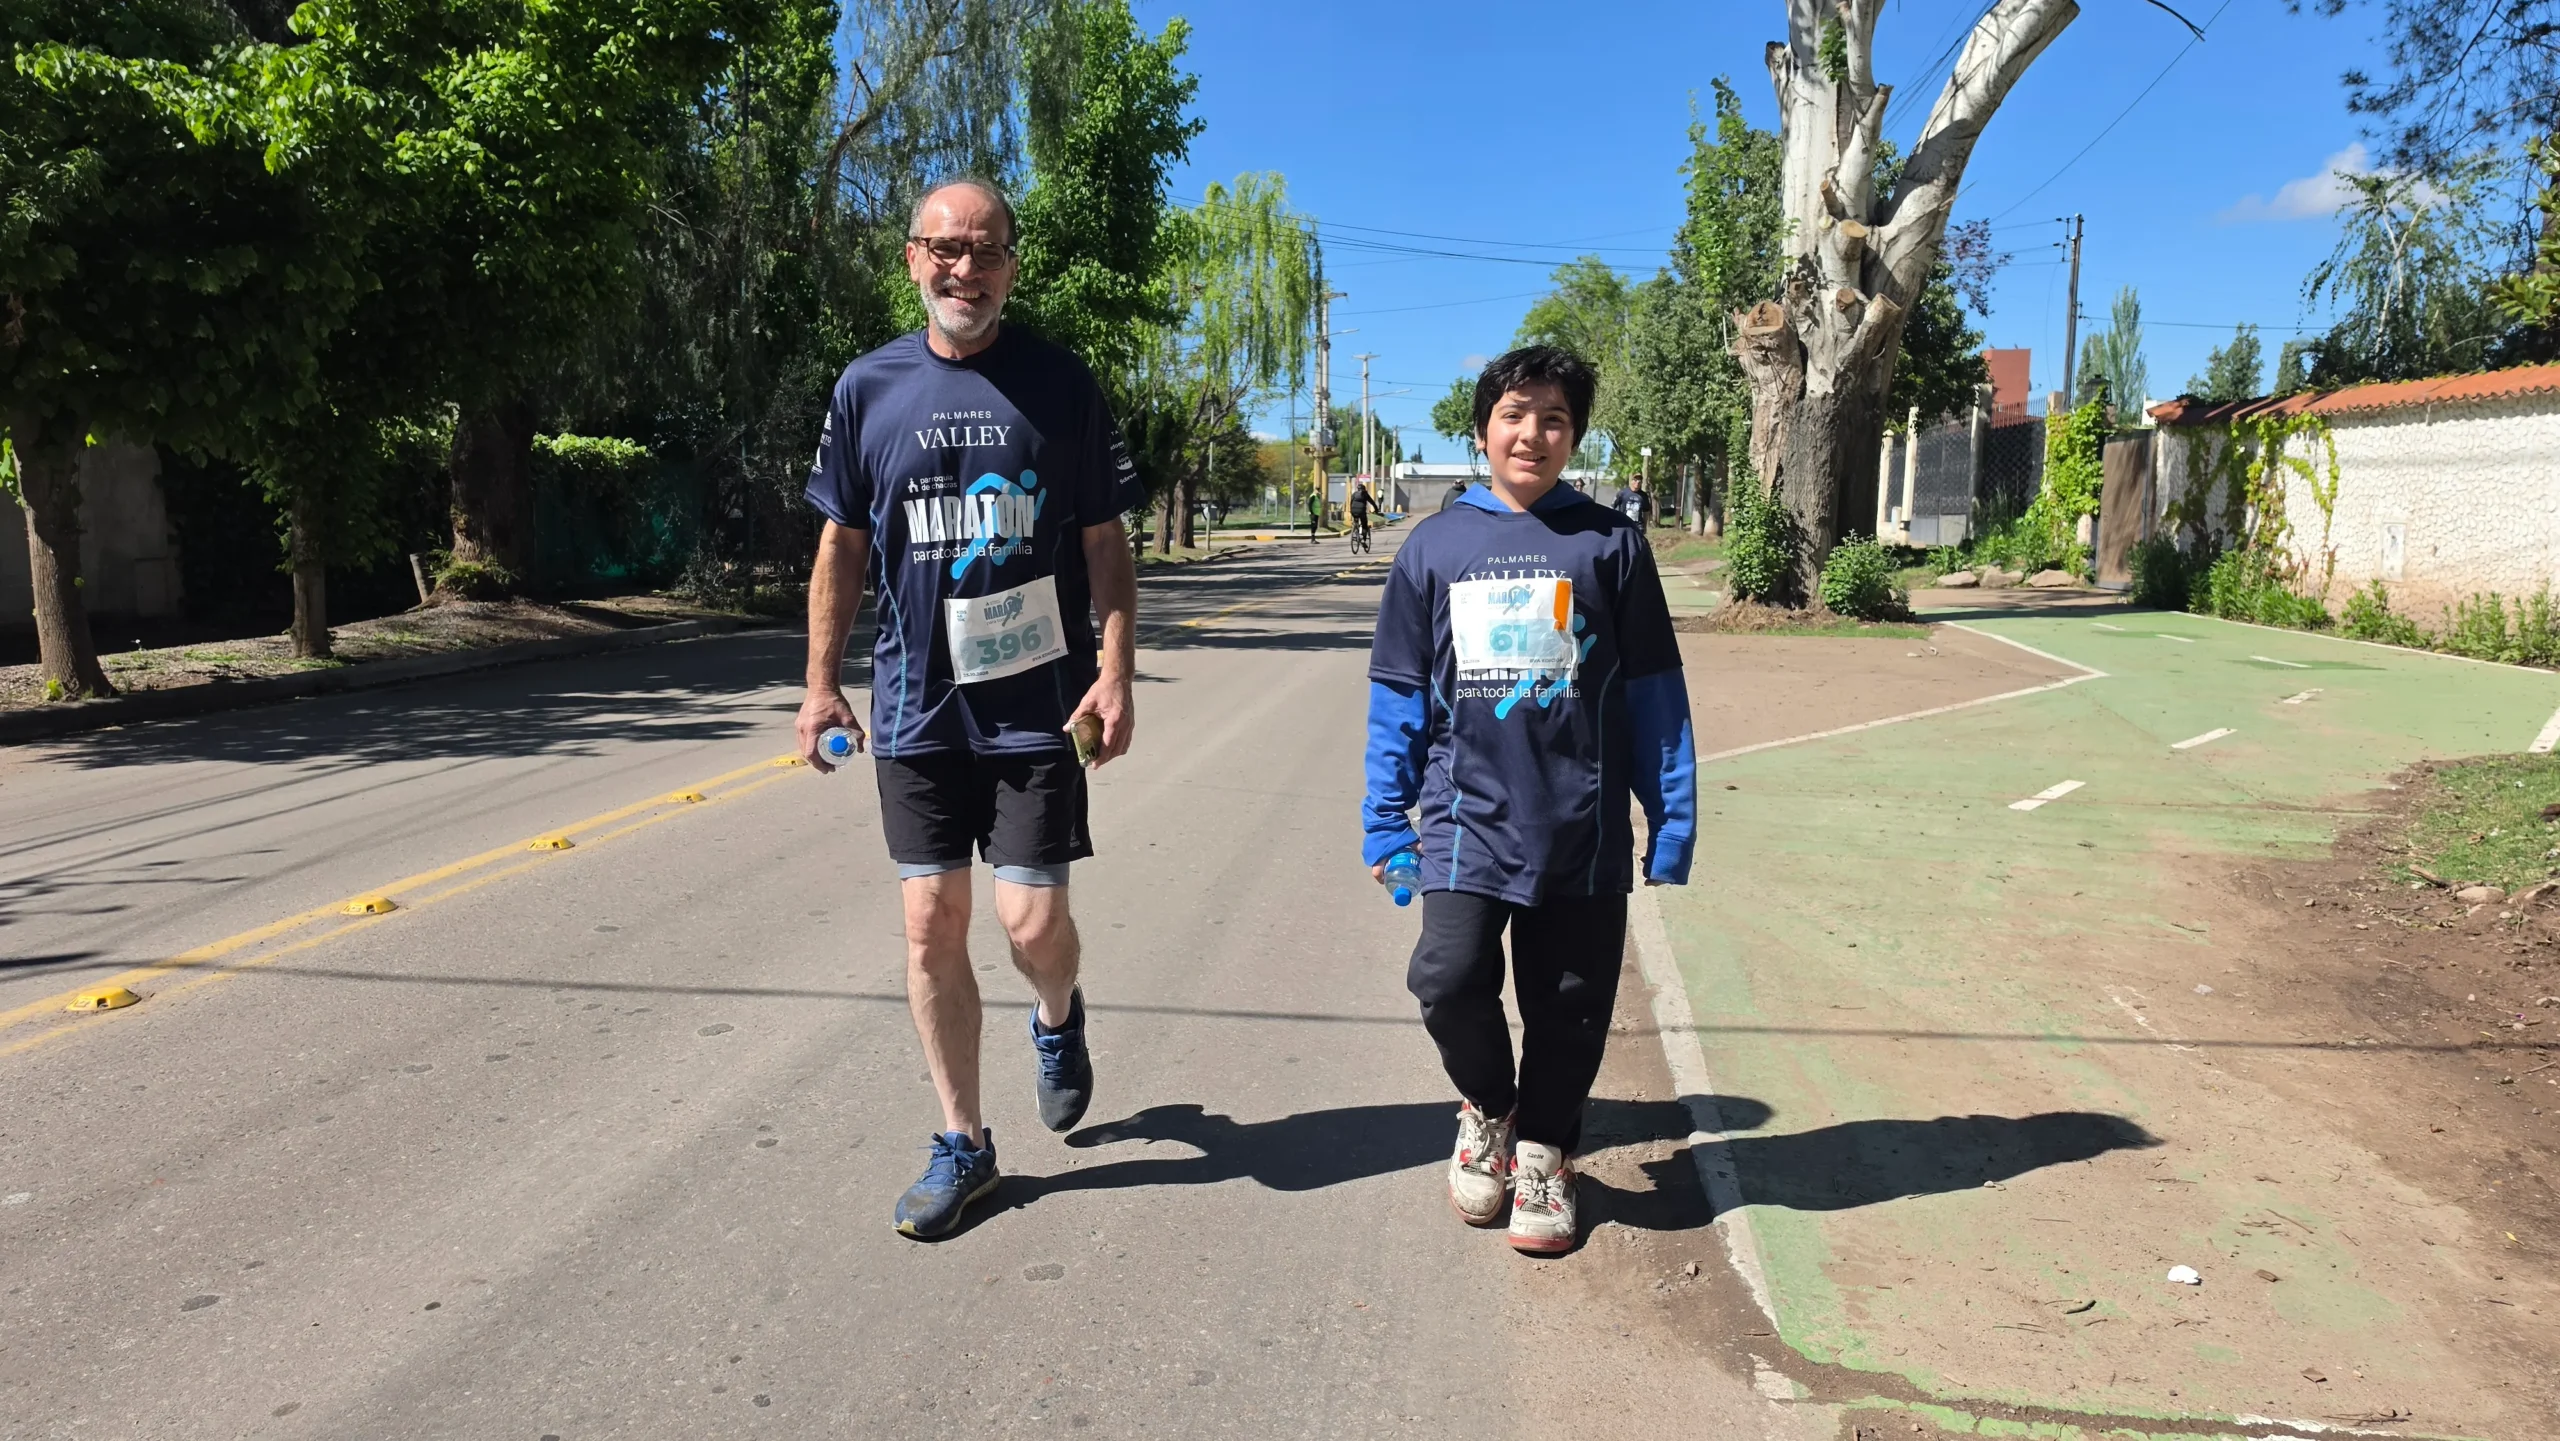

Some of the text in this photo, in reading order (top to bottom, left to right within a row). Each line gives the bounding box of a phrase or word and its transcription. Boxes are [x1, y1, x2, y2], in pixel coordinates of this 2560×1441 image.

[932, 410, 992, 421] PALMARES
[915, 425, 1011, 450] VALLEY
[920, 475, 954, 485] parroquia
[931, 481, 958, 490] chacras
[903, 482, 1035, 544] MARATÓN
[973, 544, 987, 557] la
[989, 541, 1033, 557] familia
[1487, 554, 1547, 565] PALMARES
[976, 623, 1042, 665] 396
[1489, 623, 1528, 652] 61
[1456, 684, 1581, 702] para toda la familia
